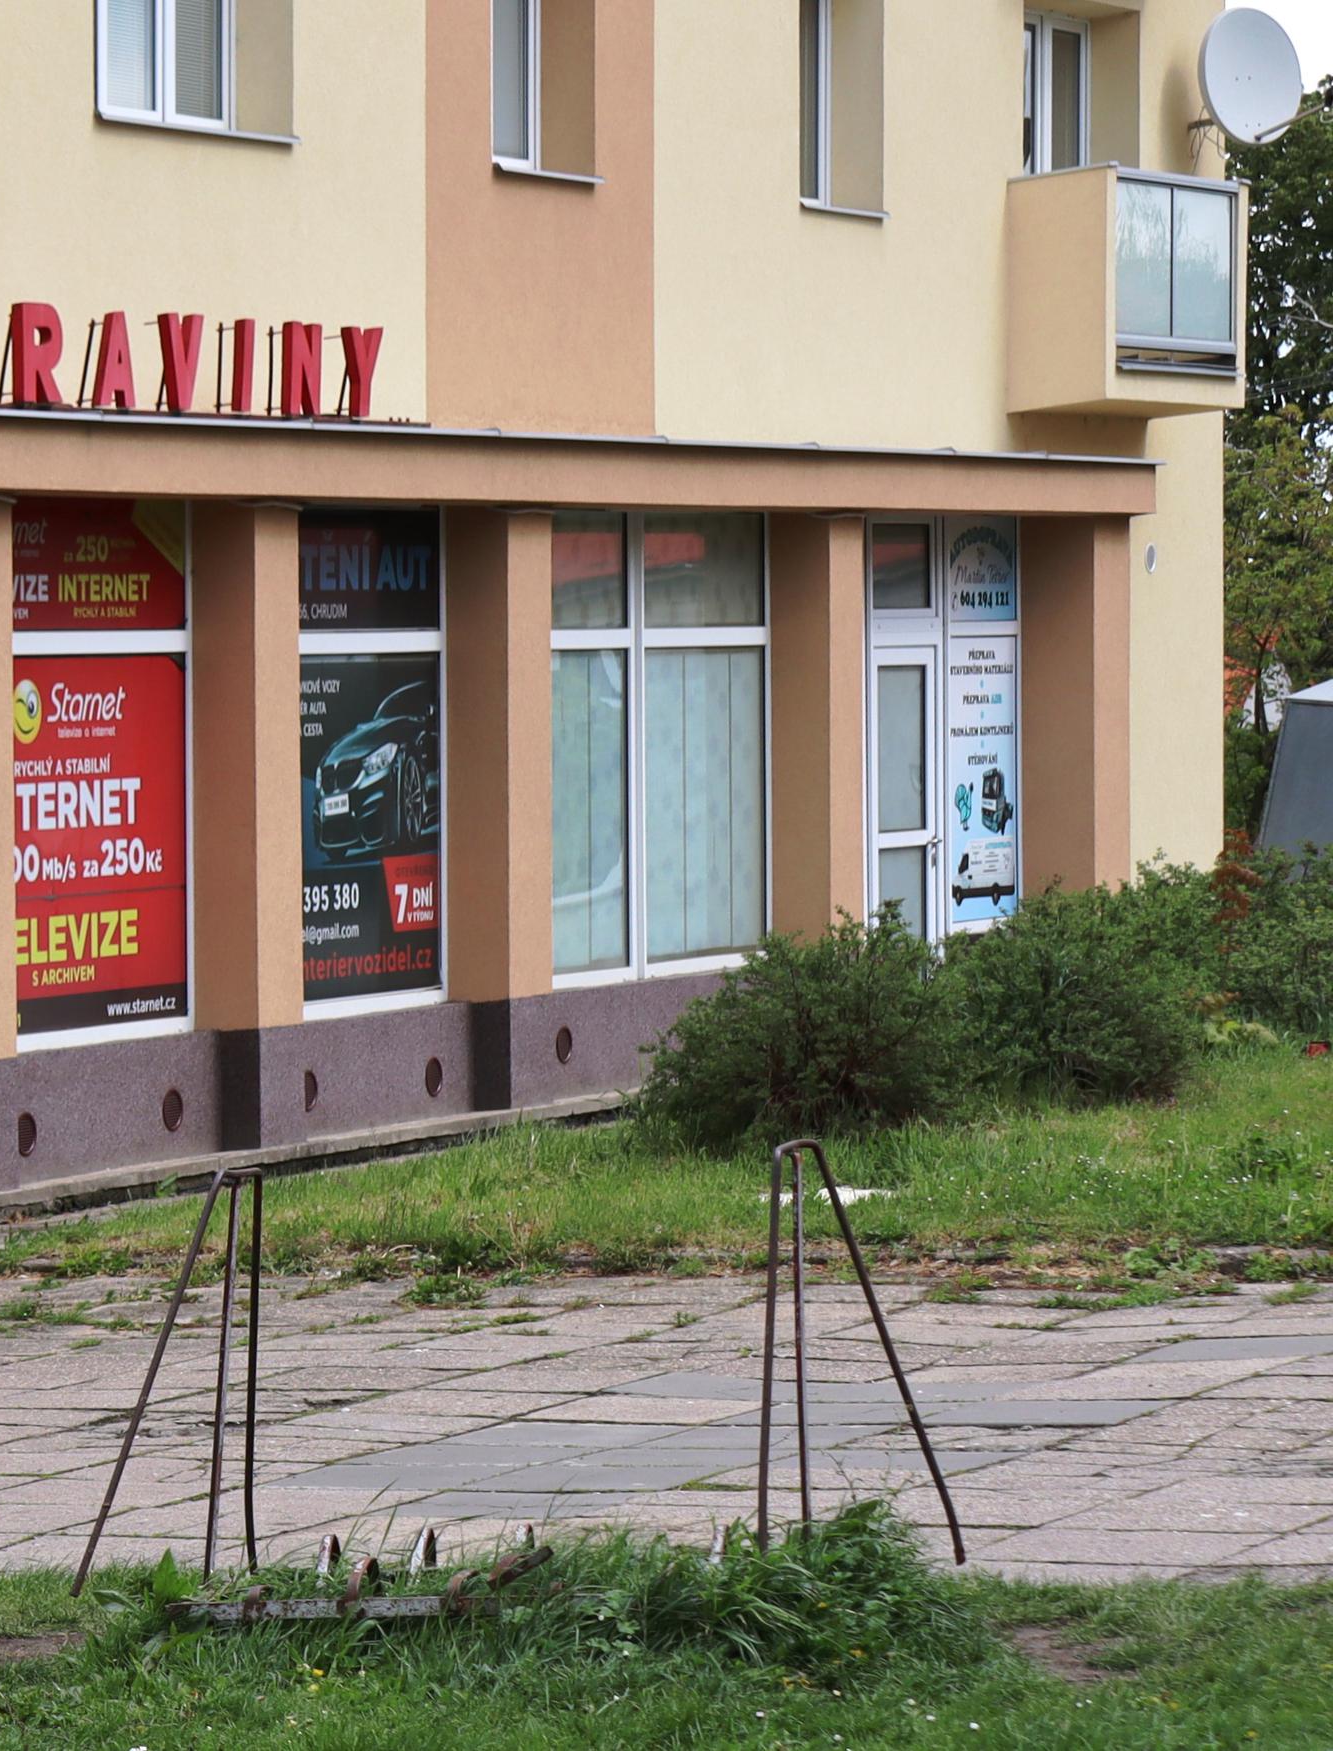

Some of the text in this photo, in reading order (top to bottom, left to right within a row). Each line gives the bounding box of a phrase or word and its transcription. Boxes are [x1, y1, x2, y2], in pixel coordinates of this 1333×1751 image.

[76, 535, 109, 563] 250
[376, 546, 431, 591] AUT
[58, 574, 151, 602] INTERNET
[960, 590, 1009, 609] 604 294 121
[74, 606, 98, 618] RYCHLÝ
[100, 608, 105, 617] A
[311, 603, 348, 619] CHRUDIM
[322, 679, 340, 693] VOZY
[47, 682, 126, 722] Starnet
[309, 701, 326, 714] AUTA
[58, 727, 82, 738] televize
[92, 726, 116, 737] internet
[303, 723, 323, 737] CESTA
[14, 753, 110, 776] RYCHLÝ A STABILNÍ
[16, 777, 141, 831] TERNET
[42, 854, 76, 883] Mb/s
[83, 859, 99, 878] za
[100, 837, 144, 876] 250
[146, 849, 163, 873] Kč
[303, 882, 360, 913] 395 380
[395, 882, 433, 924] 7 DNÍ
[14, 908, 138, 966] ELEVIZE
[32, 965, 95, 987] S ARCHIVEM
[107, 995, 176, 1017] www.starnet.cz
